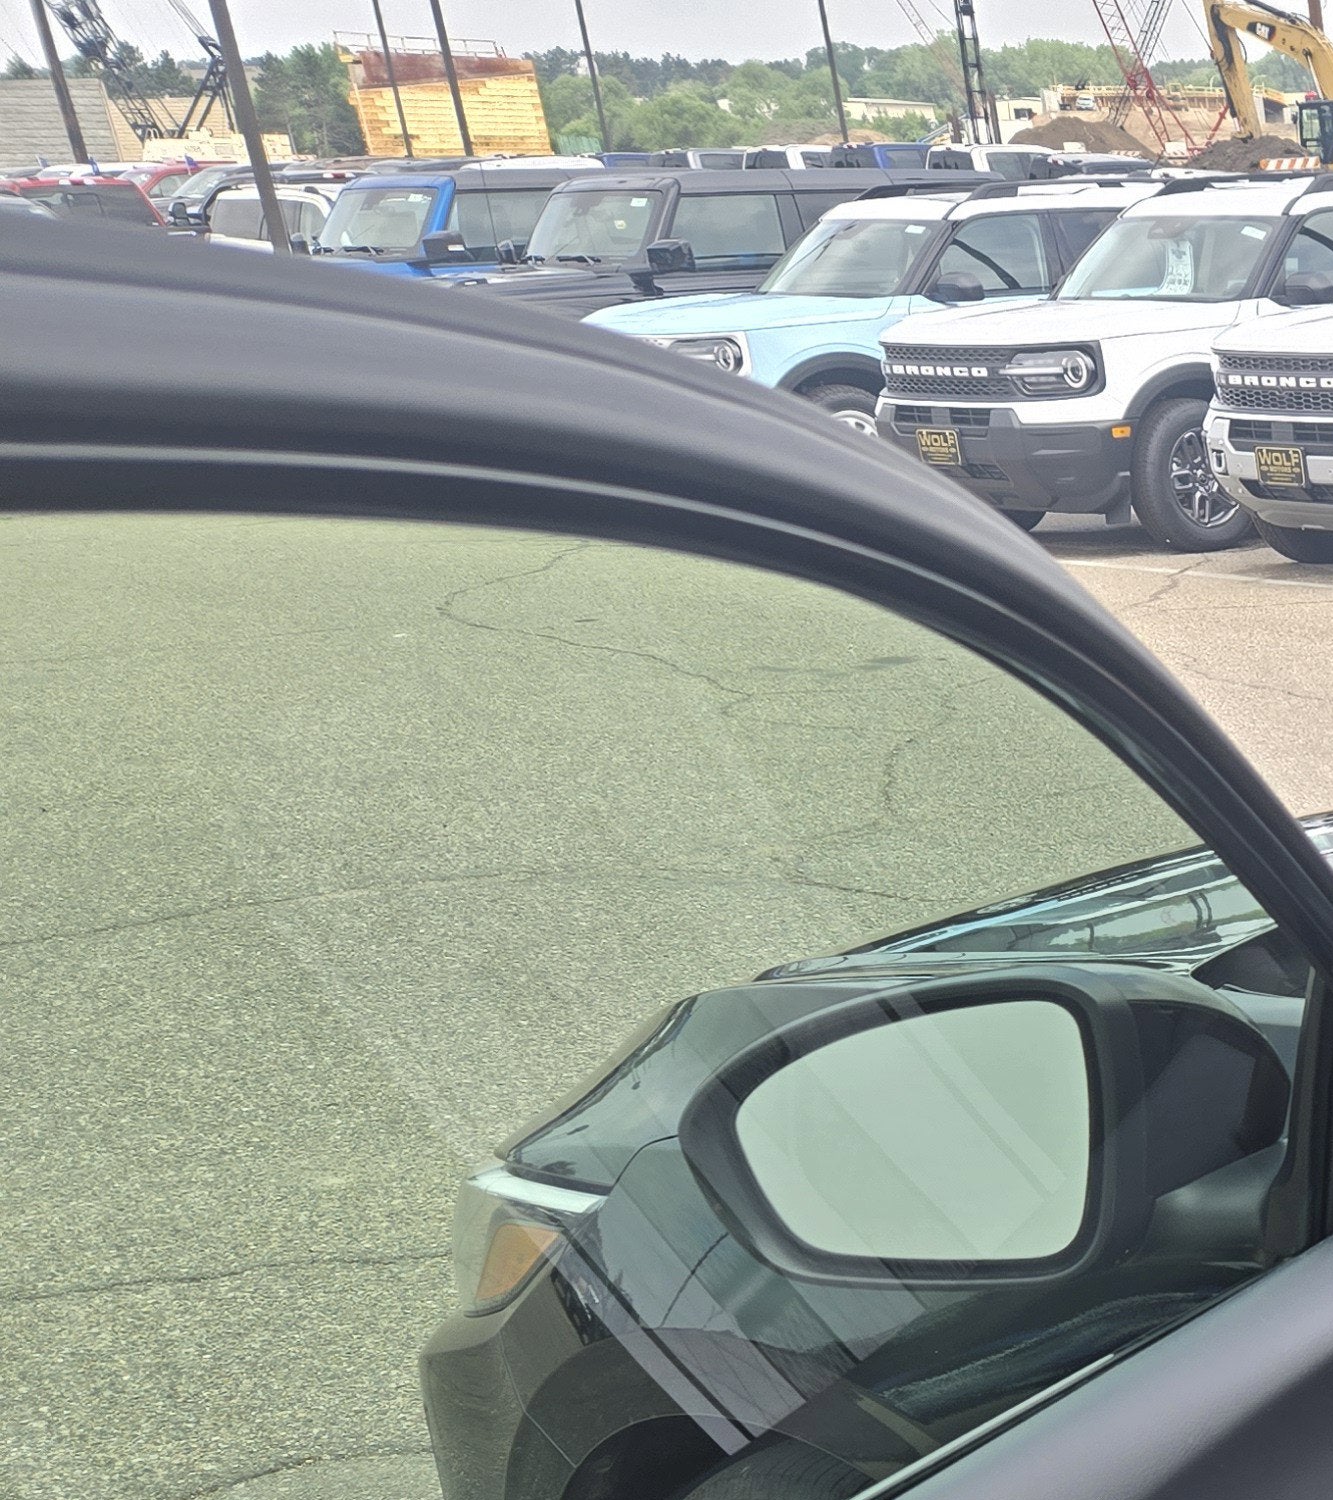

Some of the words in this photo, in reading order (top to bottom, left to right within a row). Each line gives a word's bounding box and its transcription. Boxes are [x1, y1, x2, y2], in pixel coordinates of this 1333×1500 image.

[1255, 22, 1271, 40] CAT
[892, 365, 988, 377] BRONCO
[918, 431, 955, 447] WOLF
[1258, 451, 1300, 467] WOLF
